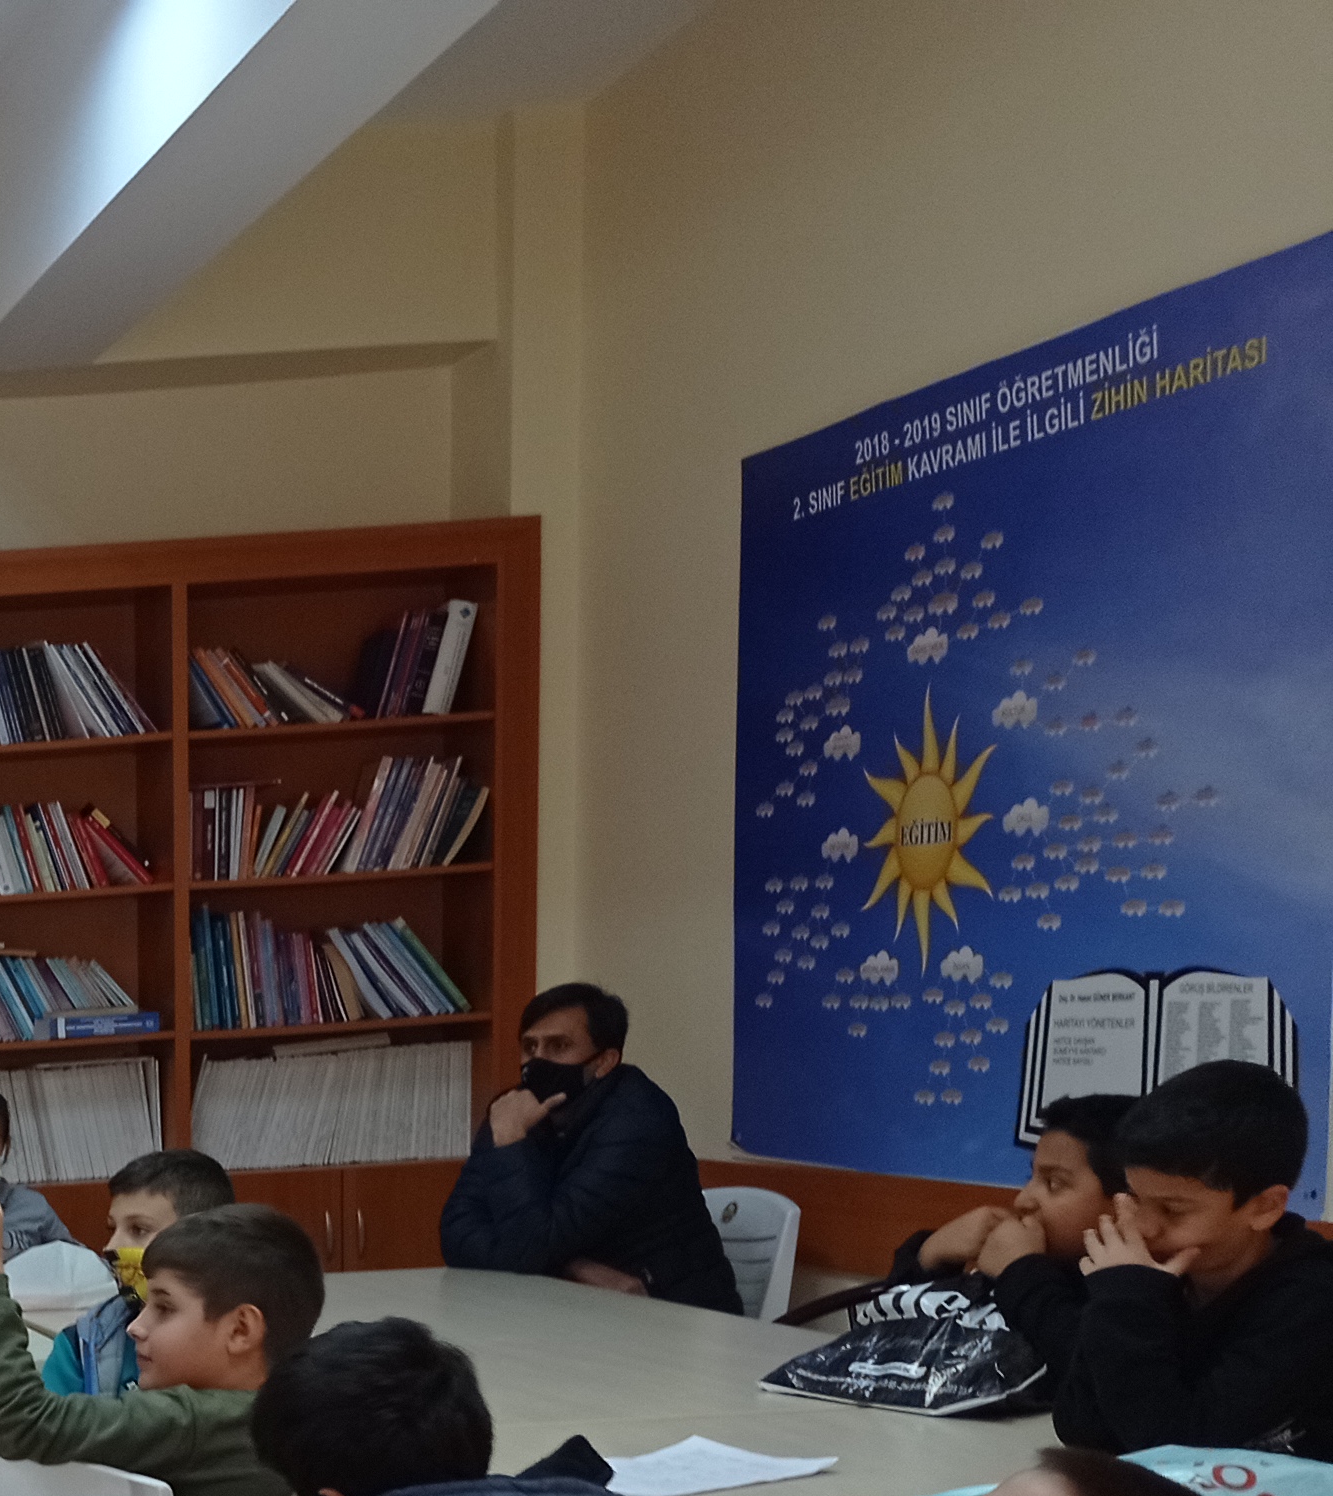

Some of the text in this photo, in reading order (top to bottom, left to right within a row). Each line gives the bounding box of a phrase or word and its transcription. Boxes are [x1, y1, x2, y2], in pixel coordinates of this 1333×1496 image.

[793, 335, 1268, 521] 2. SINIF EĞİTİM KAVRAMI İLE İLGİLİ ZİHİN HARİTASI
[855, 430, 890, 465] 2018
[903, 412, 941, 448] 2019
[946, 392, 991, 432] SINIF
[996, 323, 1159, 414] ÖĞRETMENLİĞİ
[900, 815, 952, 847] EĞİTİM
